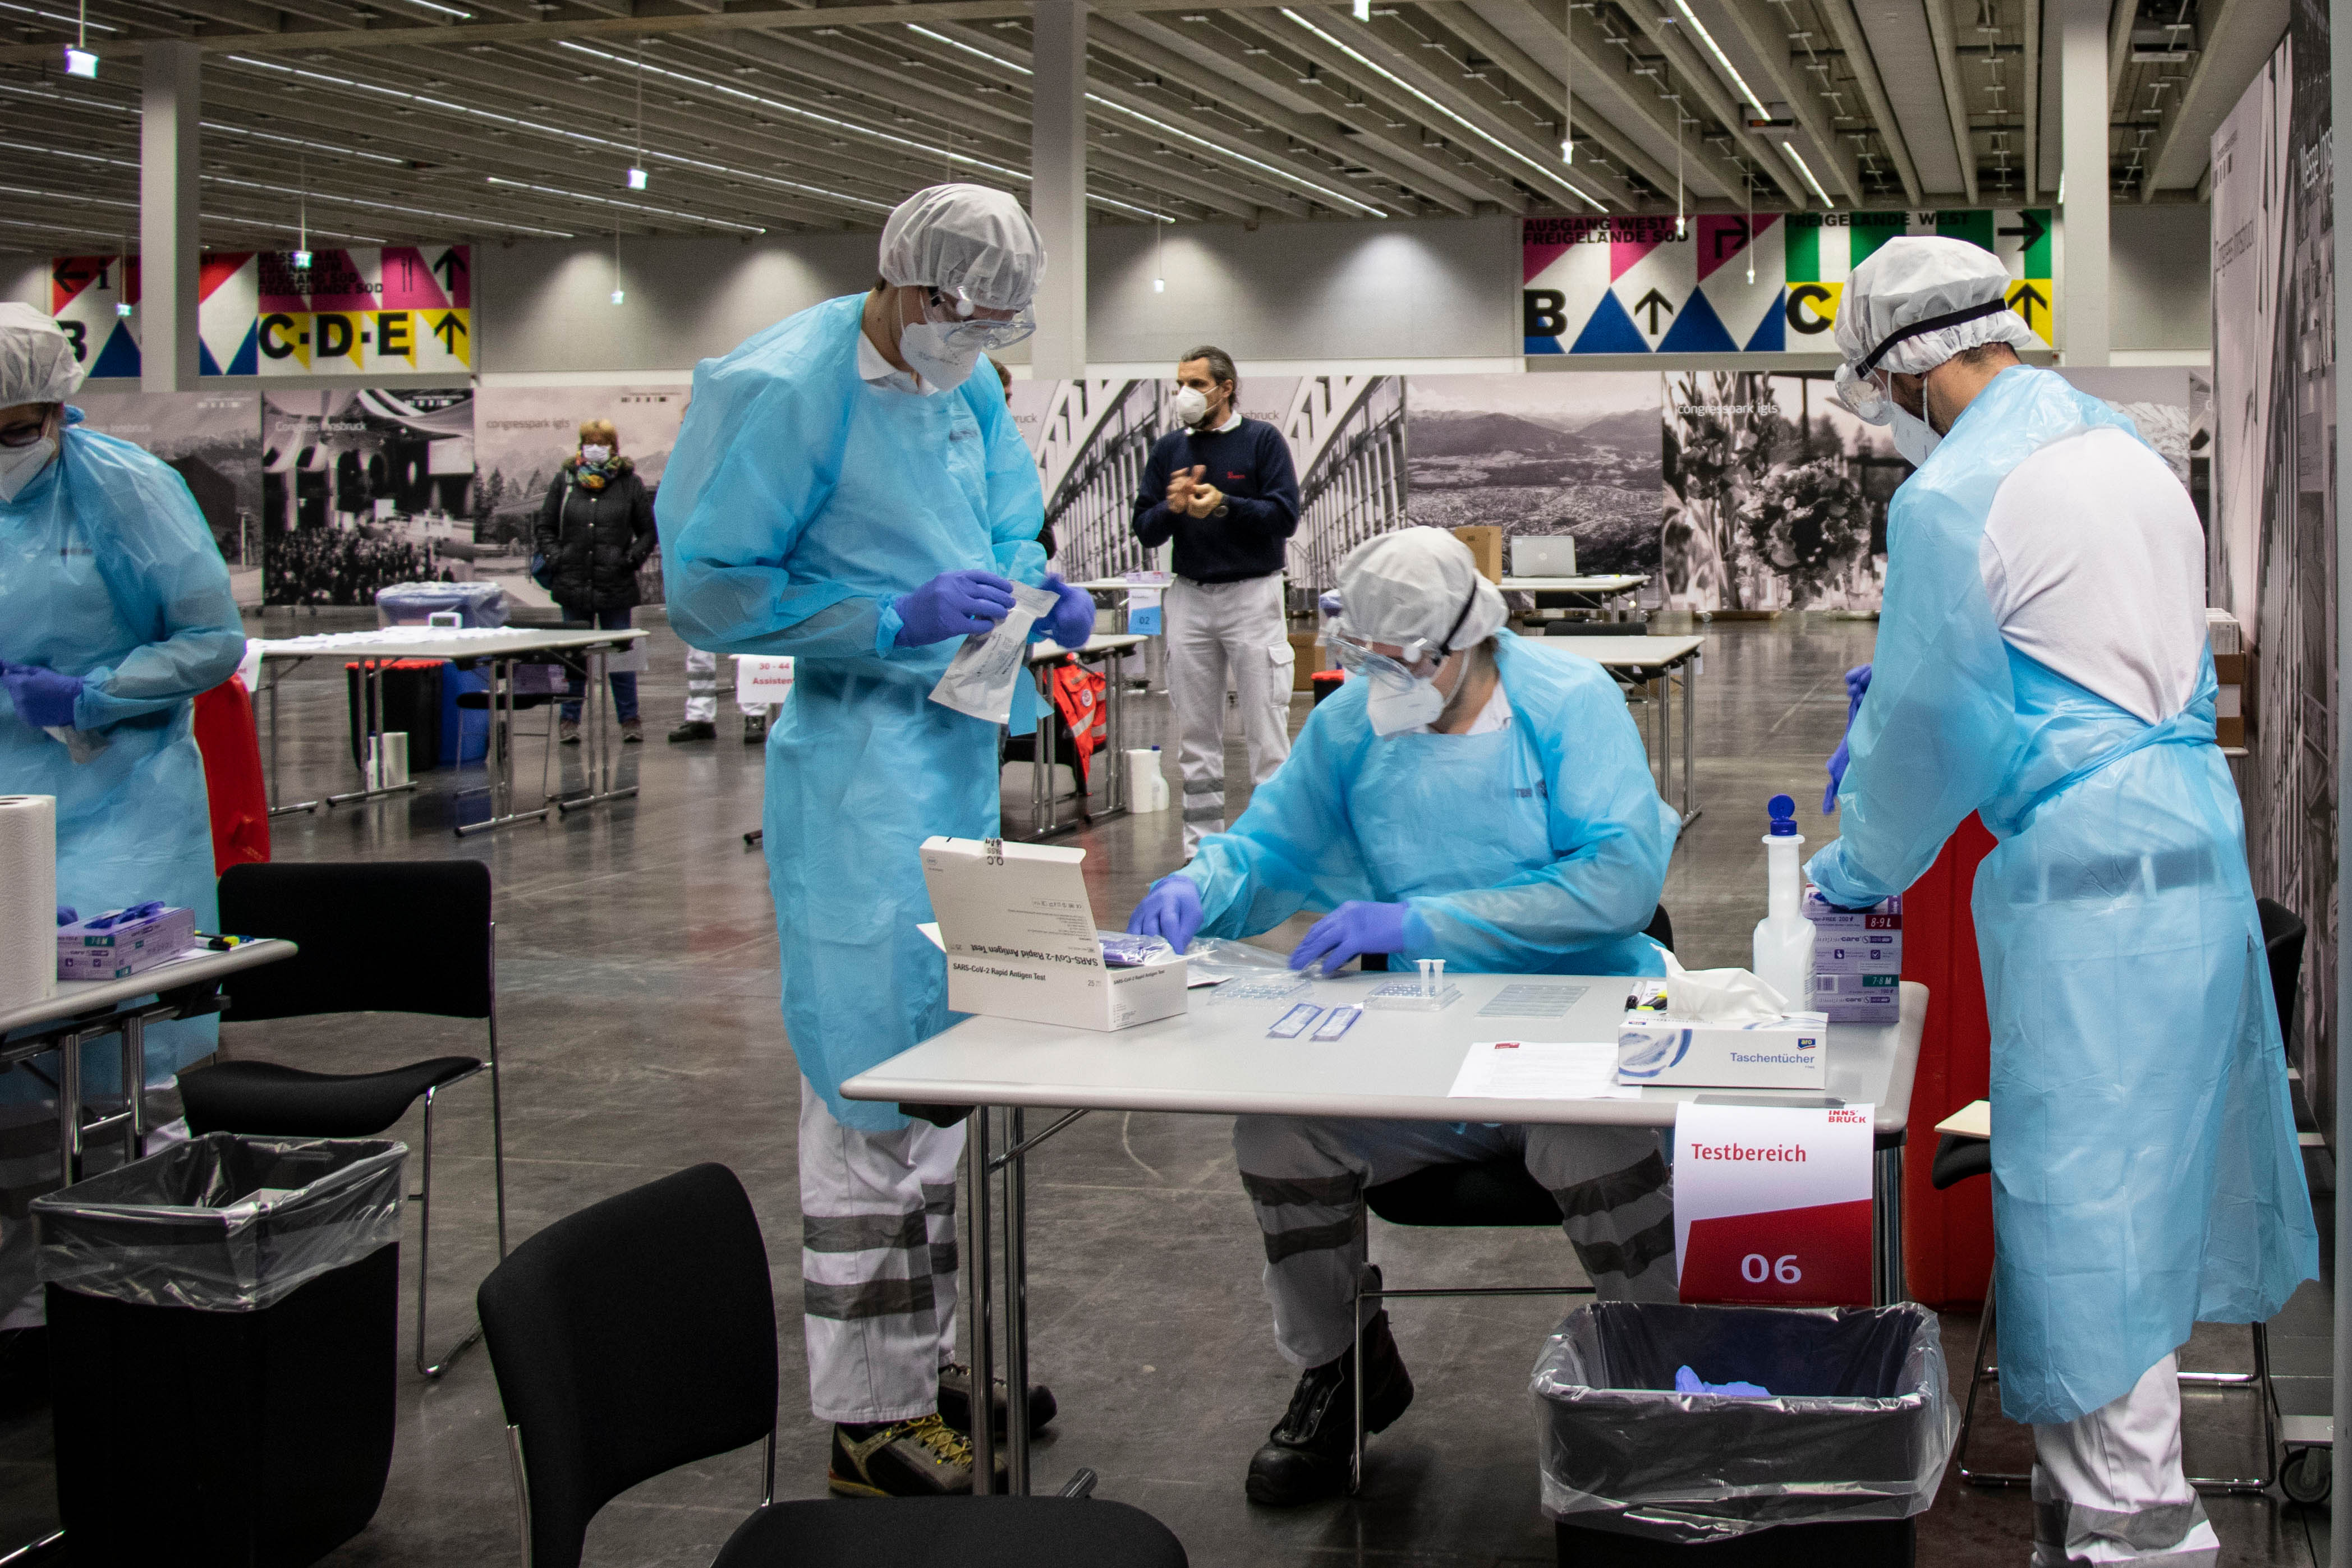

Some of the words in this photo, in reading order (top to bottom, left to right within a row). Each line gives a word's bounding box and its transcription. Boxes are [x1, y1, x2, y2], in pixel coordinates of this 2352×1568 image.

[1524, 218, 1610, 231] AUSGANG
[1618, 217, 1669, 229] WEST
[1918, 213, 1970, 226] WEST
[1523, 289, 1568, 337] B
[1785, 284, 1833, 335] C
[1757, 403, 1778, 416] igls
[1871, 917, 1885, 927] 8-9
[1886, 918, 1891, 927] L
[970, 944, 987, 953] Test
[989, 946, 1019, 958] Antigen
[1020, 950, 1044, 960] Rapid
[1045, 953, 1099, 967] SARS-CoV-2
[953, 963, 990, 974] SARS-CoV-2
[991, 969, 1008, 977] Rapid
[1009, 971, 1033, 980] Antigen
[1730, 1052, 1815, 1063] Taschentücher
[1691, 1143, 1807, 1162] Testbereich
[1741, 1253, 1802, 1284] 06
